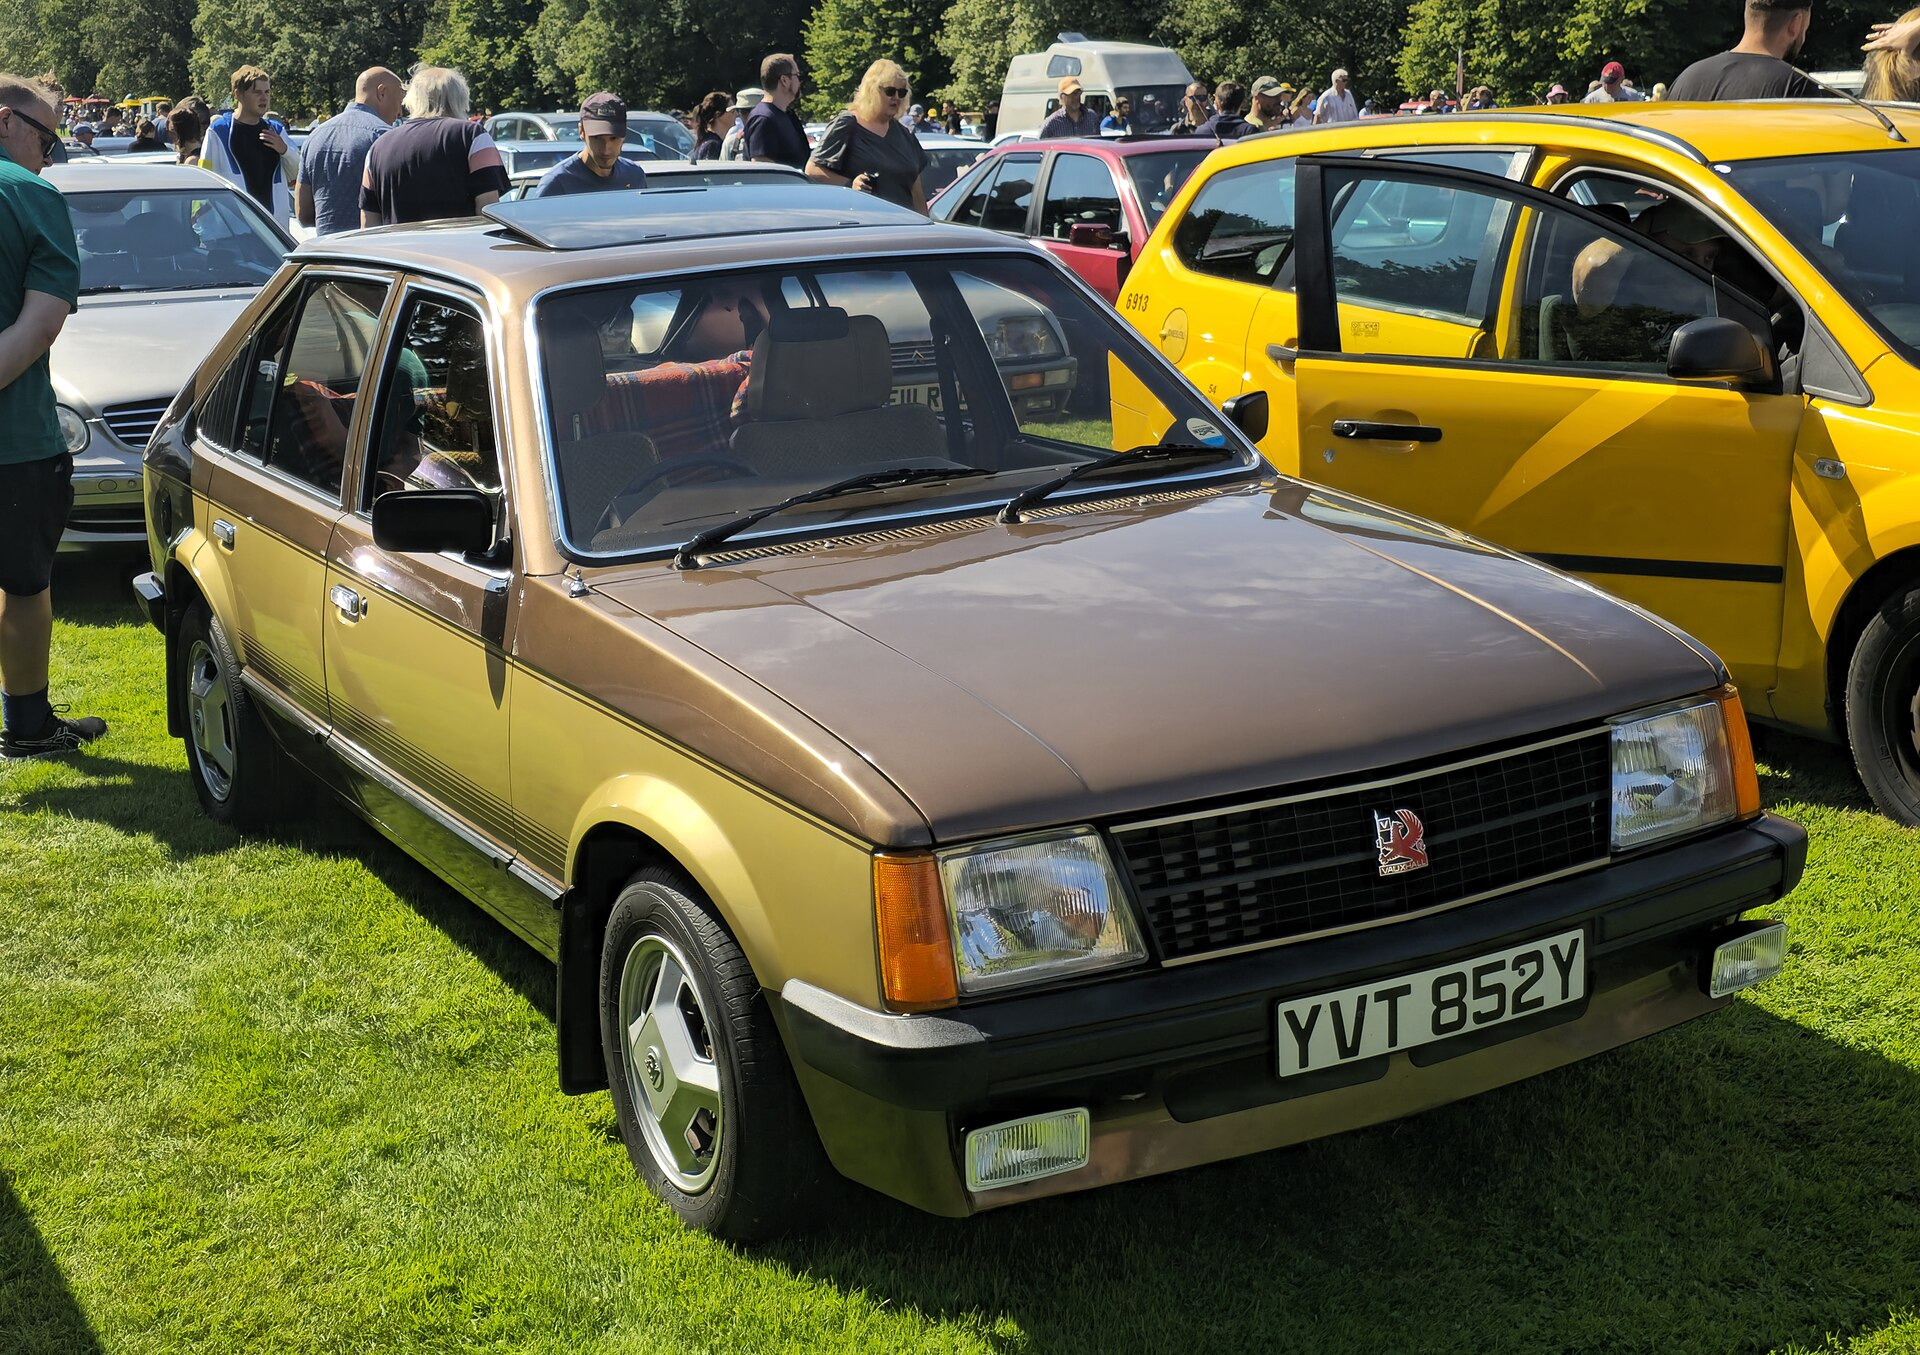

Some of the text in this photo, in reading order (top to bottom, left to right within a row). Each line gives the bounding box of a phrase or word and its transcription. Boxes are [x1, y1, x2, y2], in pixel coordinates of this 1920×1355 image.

[1126, 293, 1149, 312] 6913
[1208, 384, 1217, 394] 54
[1382, 859, 1426, 875] VAUXHALL
[1284, 937, 1579, 1069] YVT 852Y
